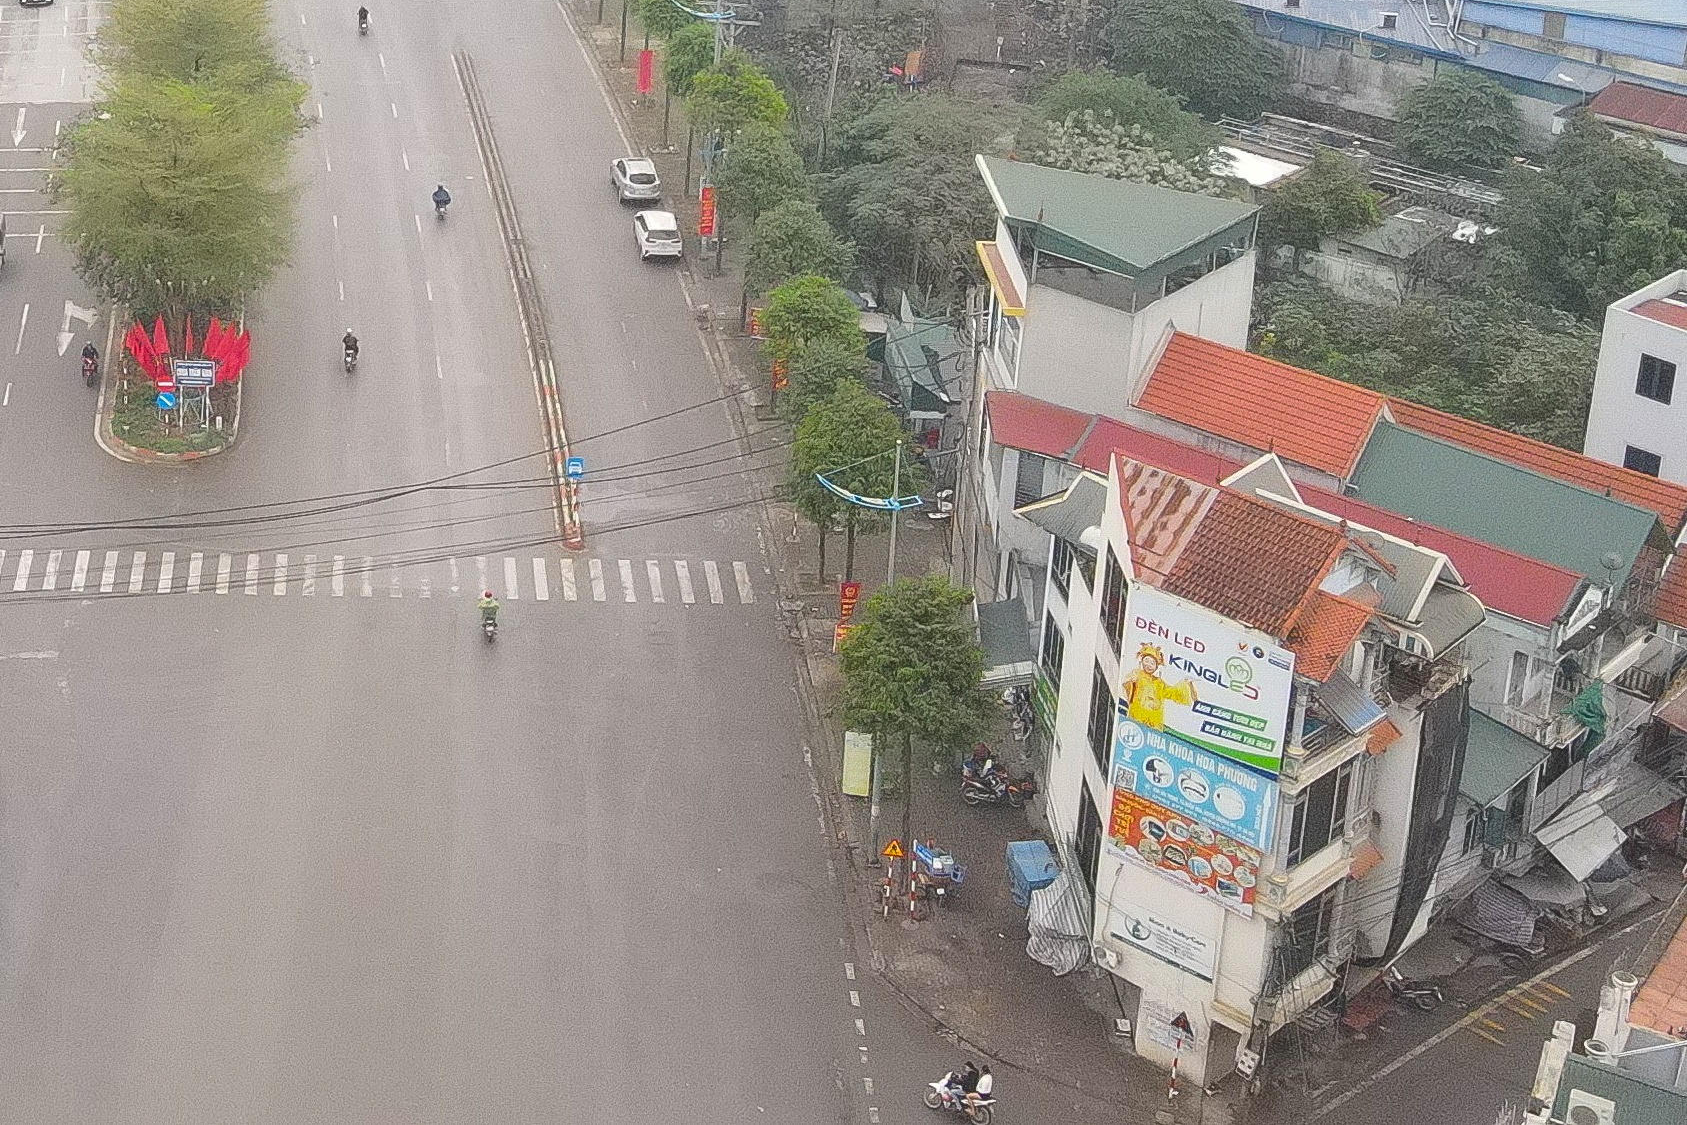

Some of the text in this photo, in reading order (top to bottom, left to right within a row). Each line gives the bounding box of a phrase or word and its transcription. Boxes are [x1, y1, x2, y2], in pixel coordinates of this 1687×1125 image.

[1174, 632, 1206, 653] LED
[1168, 653, 1260, 701] KINGLED
[1146, 732, 1166, 751] NHA
[1168, 742, 1194, 763] KHOA
